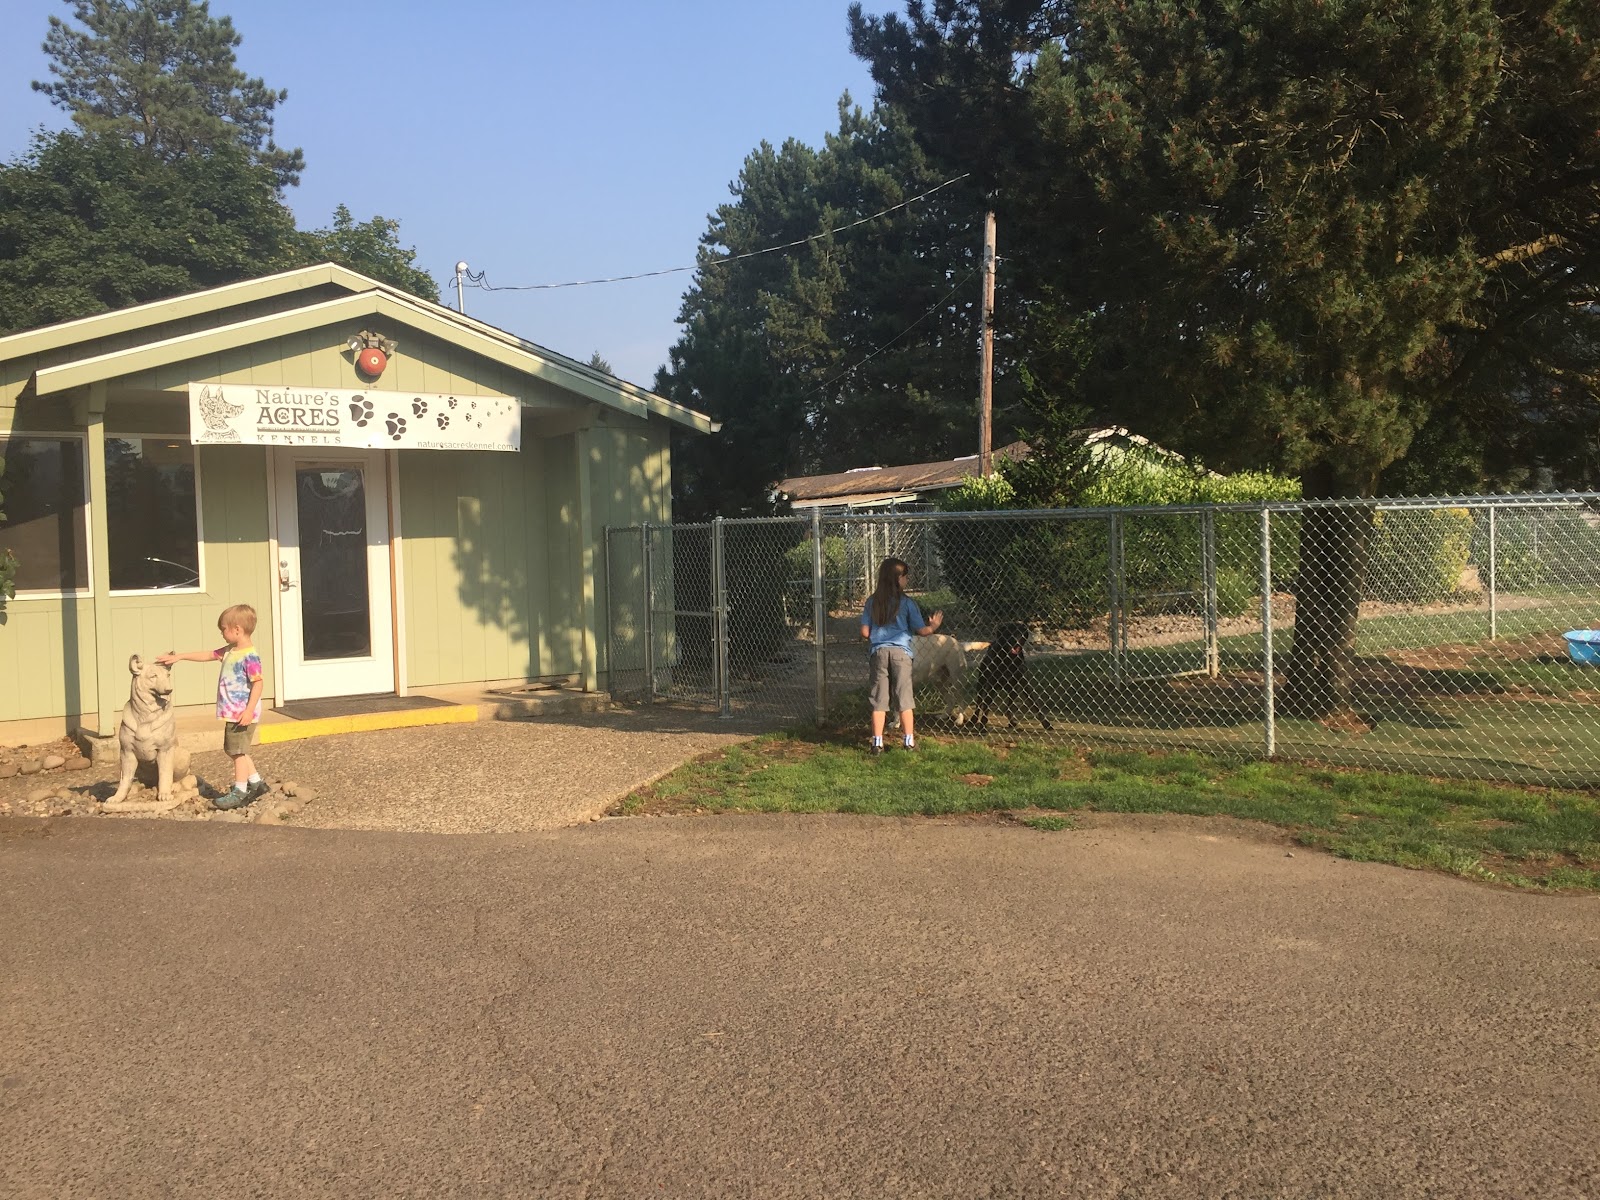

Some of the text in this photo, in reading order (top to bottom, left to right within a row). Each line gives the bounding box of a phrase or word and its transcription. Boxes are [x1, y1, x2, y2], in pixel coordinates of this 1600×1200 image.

[256, 389, 340, 406] Nature's
[256, 406, 340, 427] ACRES
[256, 434, 341, 444] KENNELS
[417, 441, 513, 450] naturesacreskennel.com
